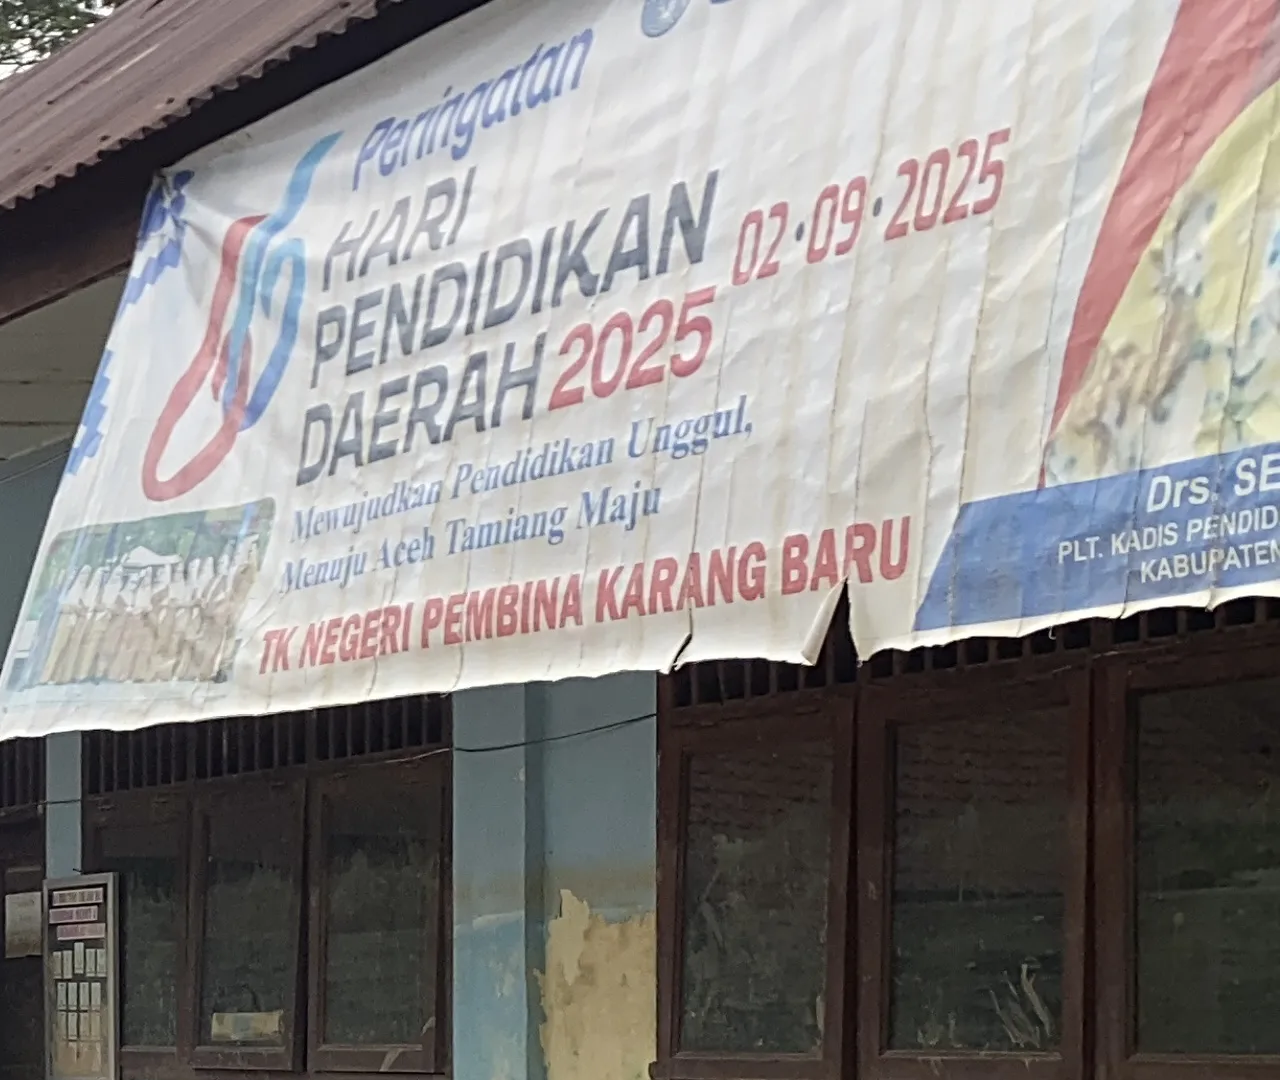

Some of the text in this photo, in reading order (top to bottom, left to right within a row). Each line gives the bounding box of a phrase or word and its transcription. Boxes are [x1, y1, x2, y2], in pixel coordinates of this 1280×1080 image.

[353, 27, 594, 191] Peringatan
[311, 170, 719, 389] PENDIDIKAN
[321, 167, 477, 290] HARI
[295, 284, 716, 486] DAERAH 2025
[279, 484, 662, 595] Menuju Aceh Tamiang Maju
[289, 395, 753, 543] Mewujudkan Pendidikan Unggul,
[1058, 504, 1280, 564] PLT. KADIS PENDID
[1146, 475, 1217, 513] Drs.
[259, 516, 912, 674] TK NEGERI PEMBINA KARANG BARU
